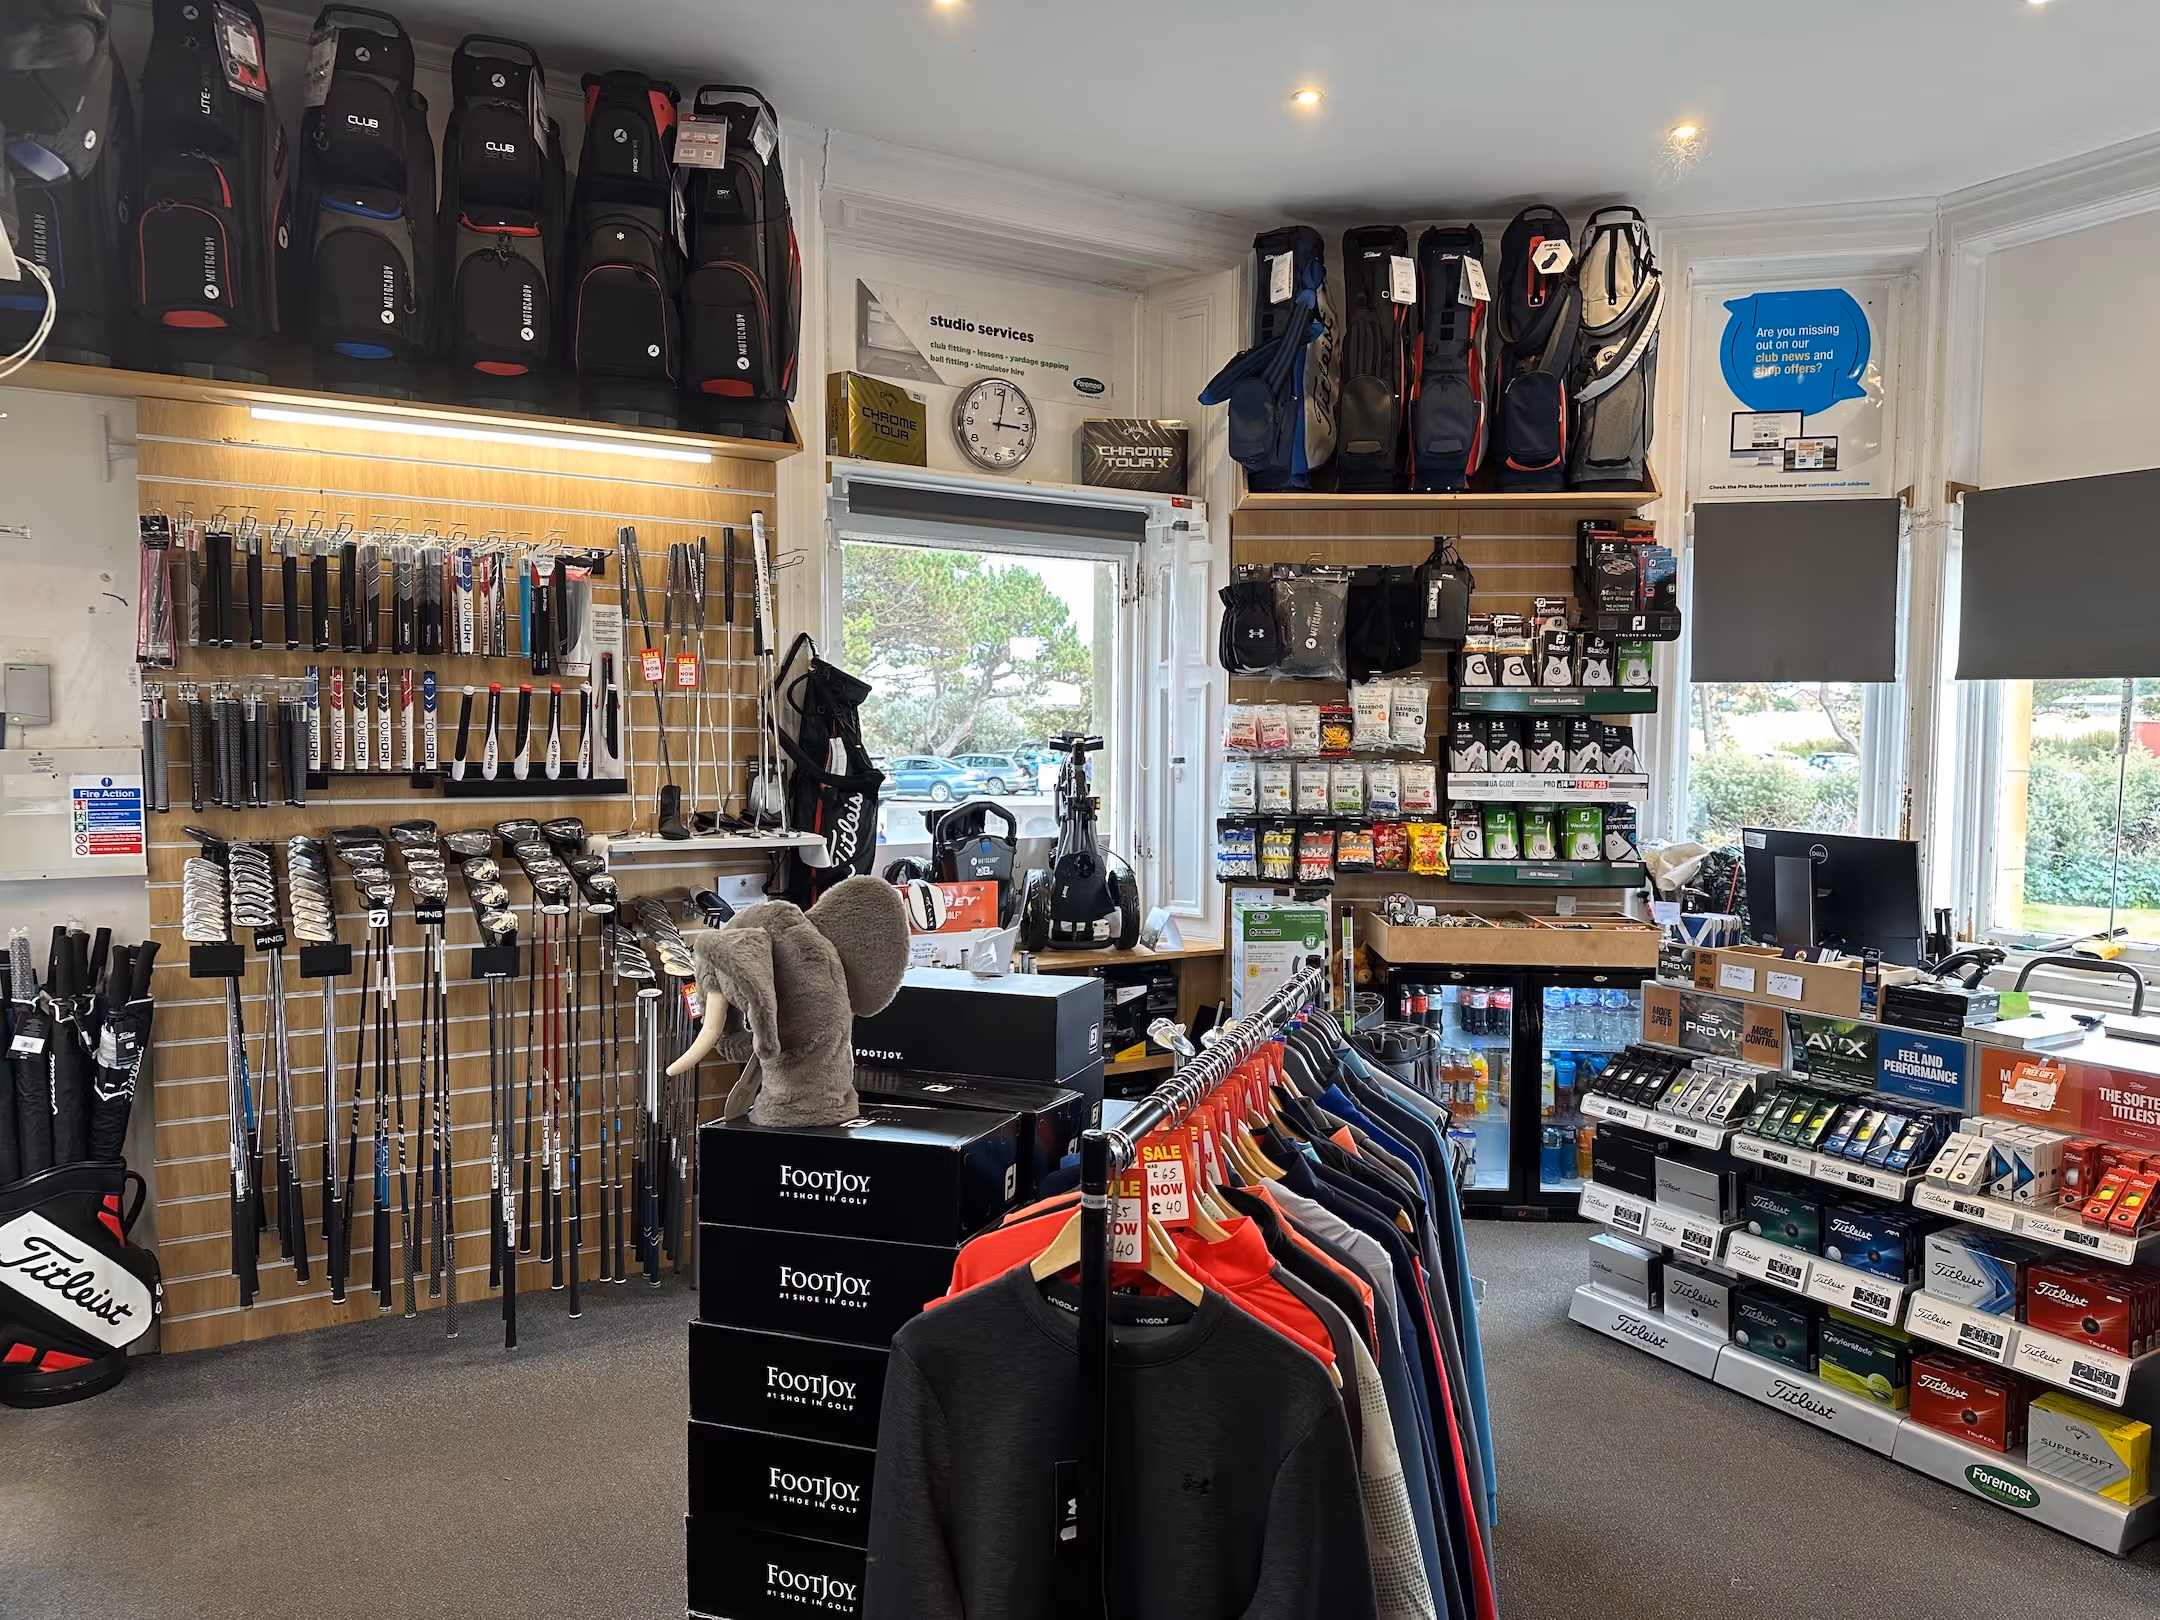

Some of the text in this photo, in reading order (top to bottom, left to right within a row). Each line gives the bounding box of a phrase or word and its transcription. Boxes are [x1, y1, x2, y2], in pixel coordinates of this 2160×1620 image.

[347, 115, 378, 129] CLUB
[485, 141, 515, 154] CLUB
[205, 236, 215, 283] MOTOCADDY
[383, 265, 394, 308] MOTOCADDY
[523, 284, 533, 326] MOTOCADDY
[736, 312, 746, 355] MOTOCADDY
[930, 315, 1034, 342] studio services
[1756, 324, 1840, 339] Are you missing
[1756, 339, 1809, 351] out on our
[930, 341, 946, 350] club
[948, 344, 971, 355] fitting
[977, 349, 1004, 360] lessons
[1010, 355, 1038, 366] yardage
[1040, 360, 1069, 371] gapping
[1755, 349, 1833, 363] club news and
[930, 354, 944, 363] ball
[946, 357, 969, 368] fitting
[975, 362, 1009, 373] simulator
[1010, 368, 1024, 376] hire
[1754, 362, 1822, 378] shop offers?
[994, 388, 1004, 397] 12
[1076, 380, 1103, 390] Foremost
[971, 402, 979, 410] 10
[1018, 407, 1026, 415] 2
[862, 406, 917, 431] CHROME
[966, 417, 974, 425] 9
[872, 422, 909, 441] TOUR
[1022, 424, 1029, 432] 3
[971, 434, 979, 442] 8
[1017, 438, 1025, 447] 4
[981, 446, 988, 456] 7
[994, 452, 1001, 461] 6
[1008, 450, 1016, 458] 5
[1099, 446, 1173, 458] CHROME
[1104, 457, 1169, 469] TOUR X
[1632, 616, 1646, 630] FJ
[309, 716, 319, 762] TOURDRI
[334, 716, 342, 762] TOURDRI
[357, 717, 366, 762] TOURDRI
[380, 716, 390, 762] TOURDRI
[380, 717, 389, 762] TOURDRI
[831, 792, 863, 878] Titleis
[256, 935, 285, 946] PING
[1306, 938, 1316, 946] 57
[1661, 961, 1691, 972] PRO V1
[1652, 1006, 1672, 1018] MORE
[1652, 1015, 1672, 1026] SPEED
[1686, 1021, 1737, 1040] PRO V1
[1751, 1026, 1774, 1037] MORE
[1745, 1034, 1780, 1048] CONTROL
[1805, 1032, 1868, 1058] AVX
[1899, 1049, 1943, 1068] FEEL AND
[1884, 1059, 1958, 1085] PERFORMANCE
[2022, 1067, 2055, 1080] FREE GIFT
[2099, 1087, 2160, 1111] THE SOFTE
[2111, 1104, 2160, 1125] TITLEIST
[1142, 1144, 1182, 1160] SALE
[1162, 1168, 1177, 1180] 65
[1150, 1183, 1182, 1196] NOW
[793, 1192, 820, 1201] SHOE
[824, 1195, 836, 1203] IN
[841, 1196, 868, 1206] GOLF
[1751, 1195, 1790, 1216] Titleist
[1151, 1200, 1182, 1215] £ 40
[1830, 1218, 1873, 1241] Titleist
[1116, 1243, 1134, 1256] 40
[1931, 1262, 1985, 1288] Titleist
[793, 1294, 820, 1304] SHOE
[824, 1297, 836, 1305] IN
[841, 1299, 868, 1309] GOLF
[1670, 1279, 1720, 1309] Titleist
[1932, 1287, 1962, 1300] VELOCITY
[2035, 1281, 2089, 1308] Titleist
[1739, 1304, 1778, 1327] Titleist
[1611, 1314, 1669, 1349] Titleist
[1822, 1330, 1874, 1357] TaylorMade
[1917, 1374, 1968, 1400] Titleist
[780, 1393, 806, 1404] SHOE
[827, 1401, 854, 1412] GOLF
[1766, 1380, 1837, 1420] Titleist
[2040, 1438, 2114, 1469] SUPERSOFT
[1972, 1467, 2033, 1502] Foremost
